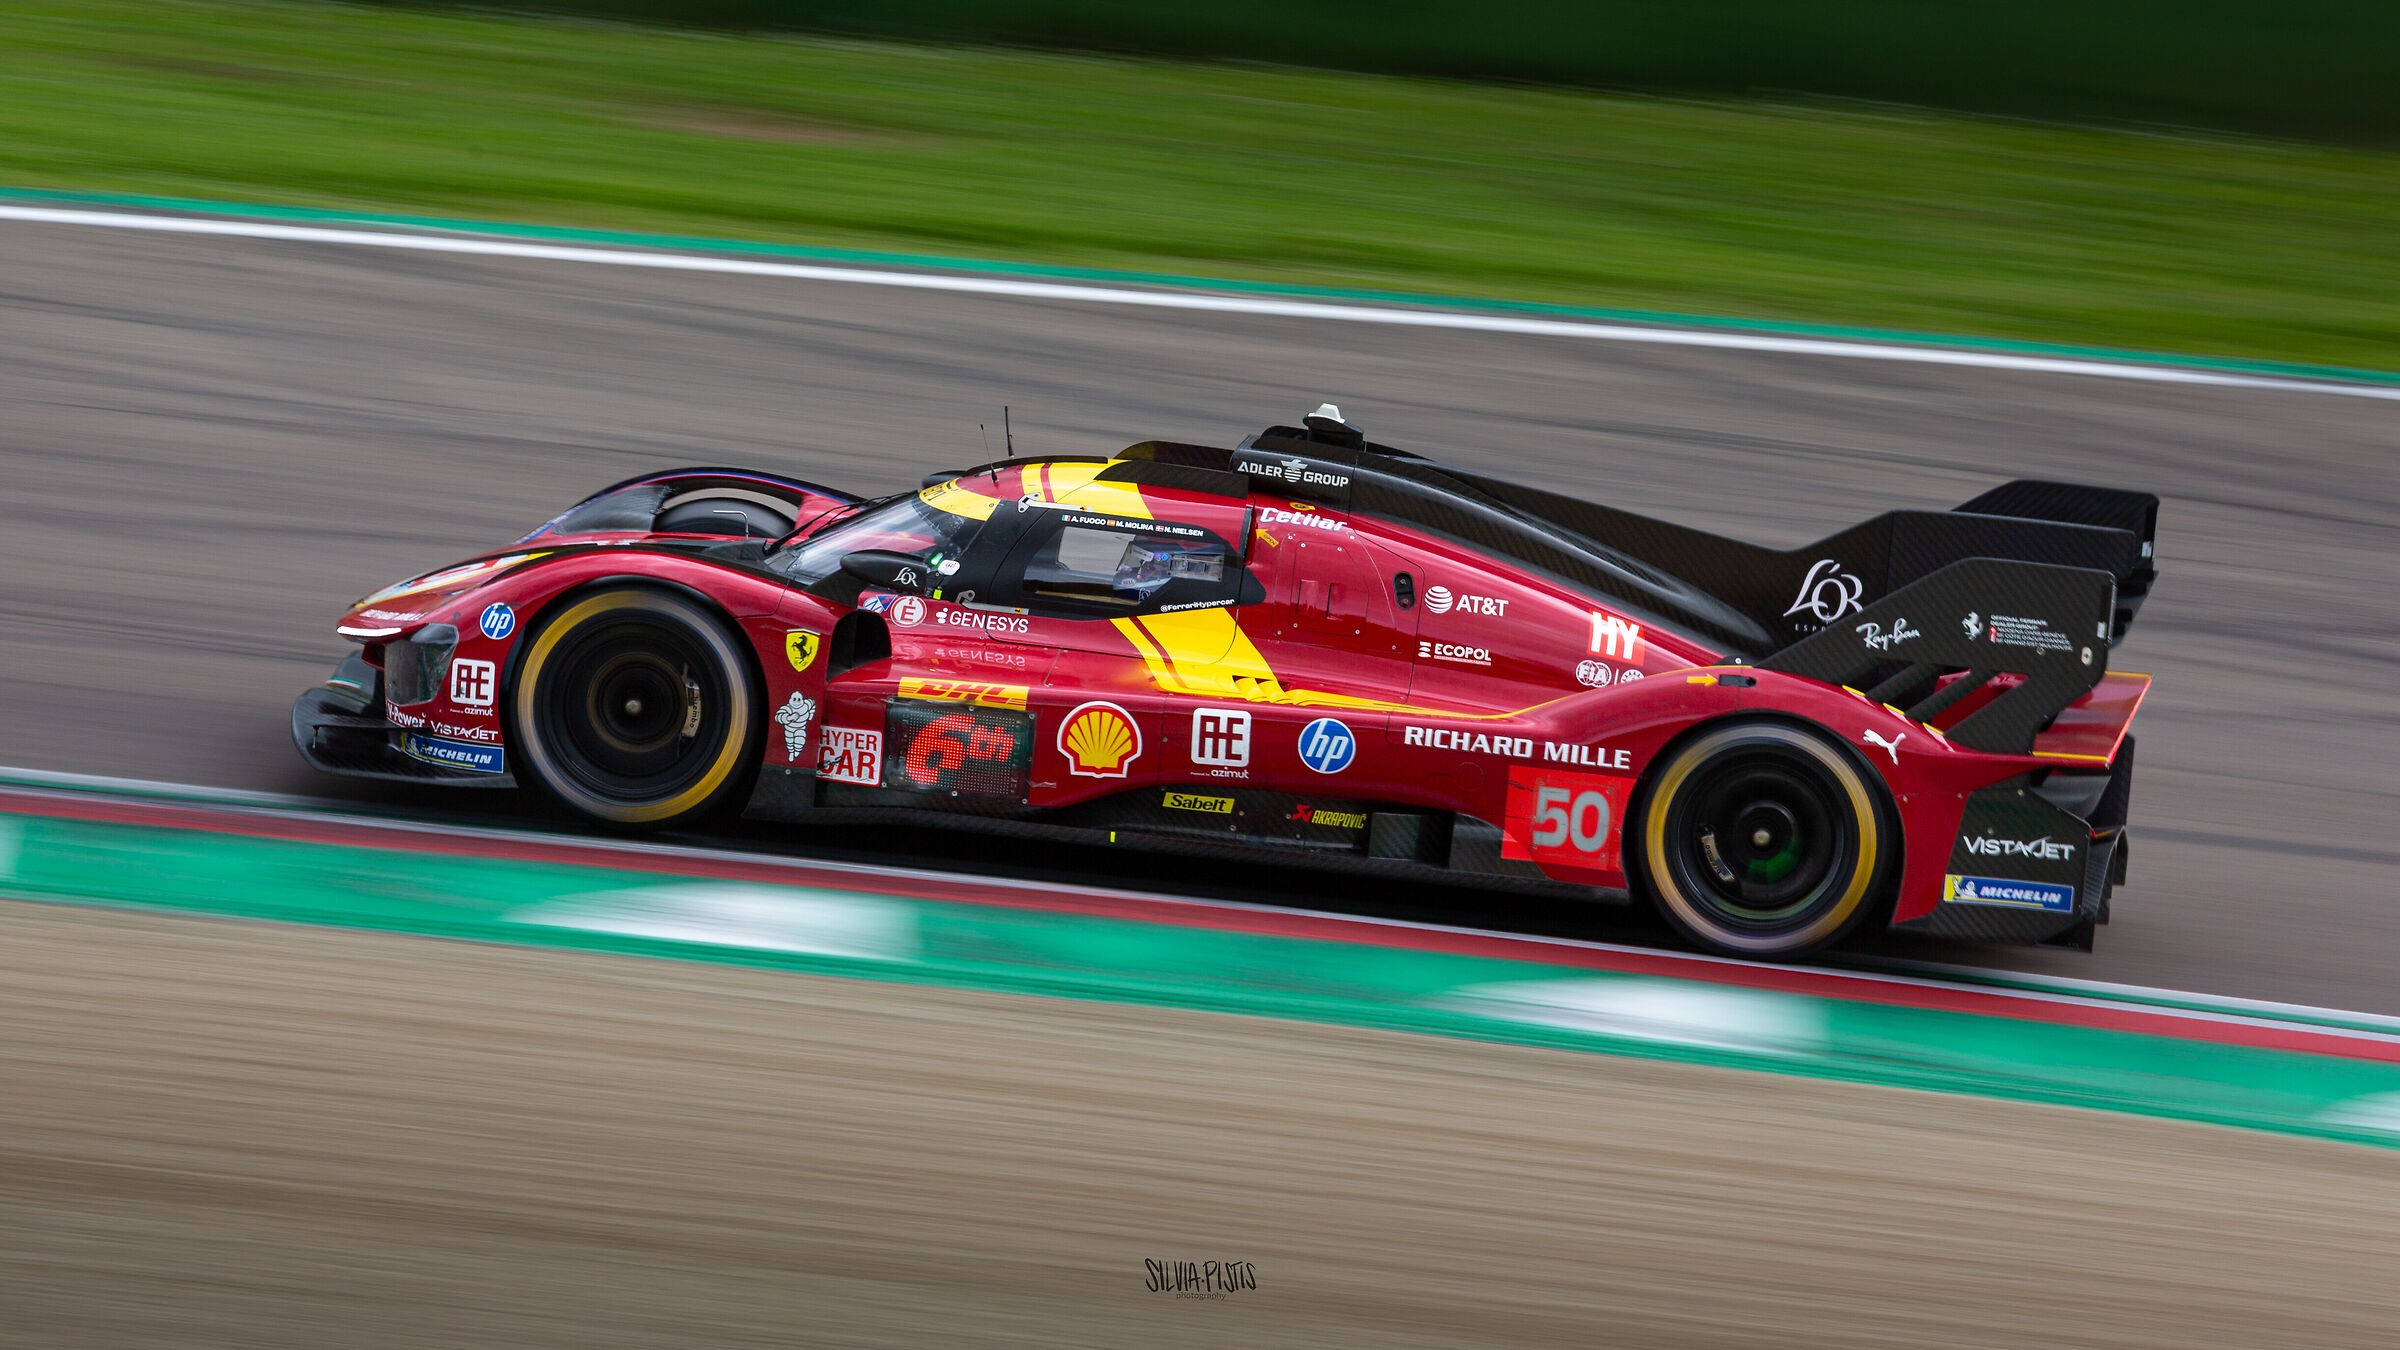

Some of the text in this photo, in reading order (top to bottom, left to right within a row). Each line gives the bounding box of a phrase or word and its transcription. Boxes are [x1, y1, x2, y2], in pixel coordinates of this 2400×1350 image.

[1237, 461, 1349, 487] ADLER GROUP
[1070, 515, 1106, 526] A. FUOCO
[1115, 520, 1154, 531] M. MOLINA
[1260, 507, 1347, 531] Cetilar
[1164, 526, 1204, 537] N. NIELSEN
[900, 605, 916, 622] E
[1160, 598, 1235, 613] @FerrariHypercar
[1456, 594, 1509, 617] AT&T
[484, 603, 512, 639] hp
[949, 610, 1029, 633] GENESYS
[1590, 611, 1640, 660] HY
[1434, 643, 1491, 661] ECOPOL
[1577, 663, 1609, 685] FIA
[915, 680, 1008, 704] DHL
[387, 703, 425, 728] V-Power
[464, 704, 494, 717] azimut
[820, 729, 878, 751] HYPER
[906, 714, 1014, 785] 6th
[1305, 719, 1349, 773] hp
[1404, 726, 1631, 770] RICHARD MILLE
[421, 743, 493, 764] MICHELIN
[817, 746, 876, 779] CAR
[1210, 766, 1249, 779] azimut
[1170, 794, 1226, 812] Sabelt
[1533, 785, 1610, 852] 50
[1963, 835, 2076, 861] VISTAJET
[1980, 886, 2062, 903] MICHELIN
